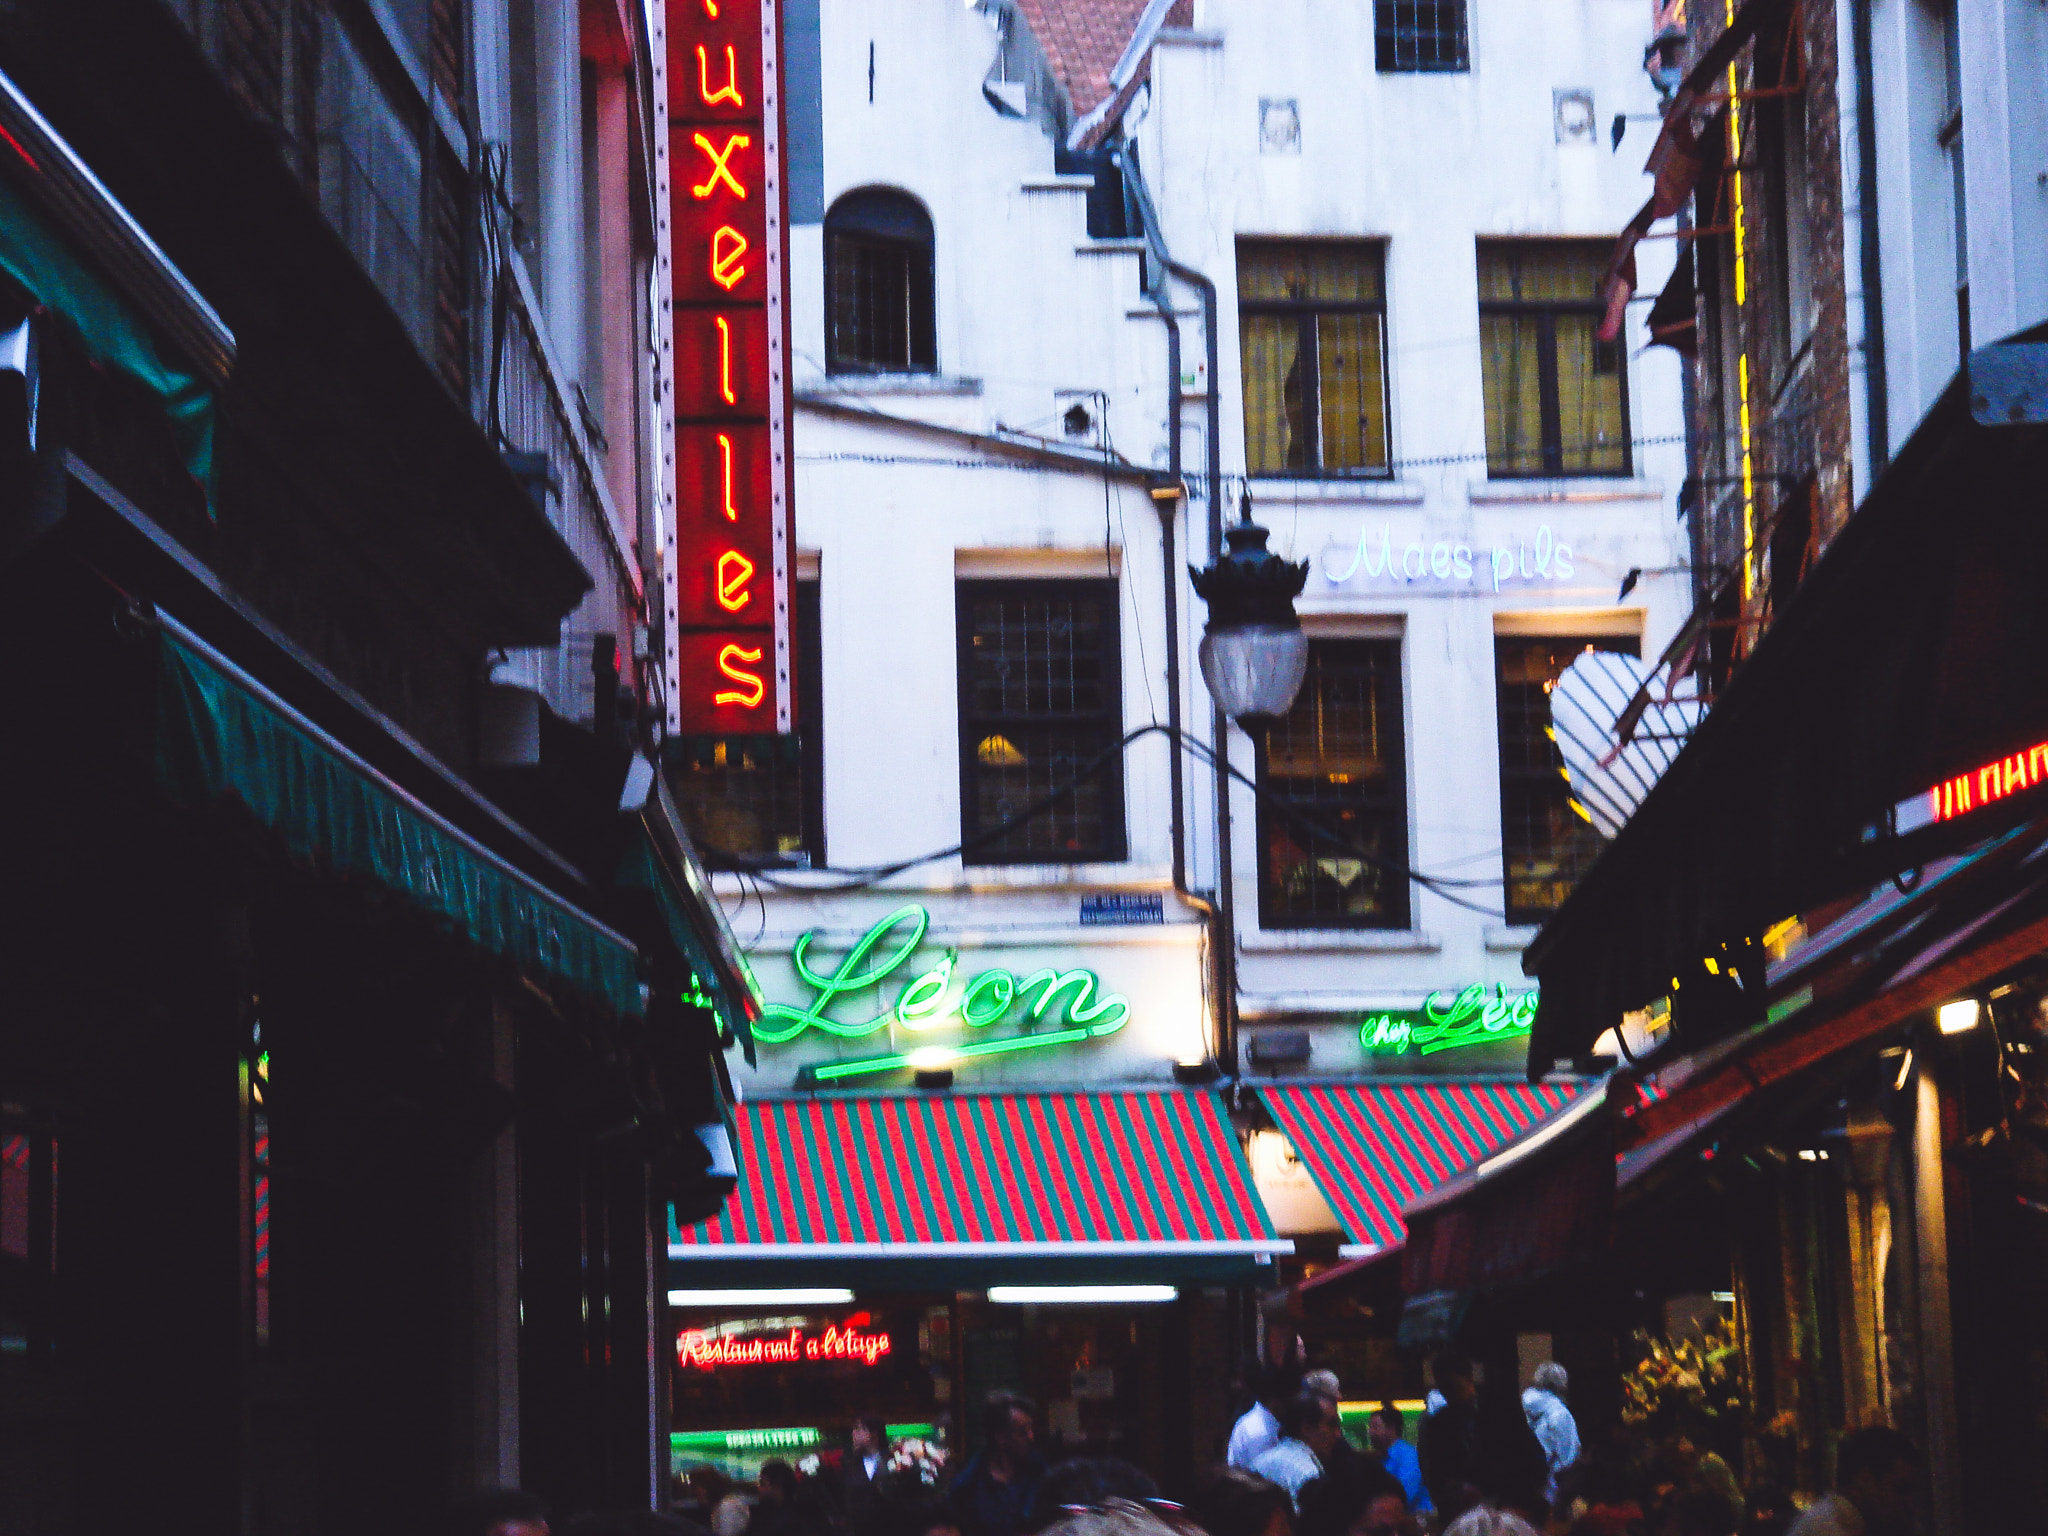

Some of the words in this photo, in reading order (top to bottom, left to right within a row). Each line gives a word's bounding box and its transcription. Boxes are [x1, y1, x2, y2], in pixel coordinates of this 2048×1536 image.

[690, 0, 765, 710] uxelles
[1323, 521, 1474, 583] Maes
[1490, 523, 1576, 593] pils
[1411, 980, 1540, 1046] Léo
[680, 1326, 802, 1368] Restaurant
